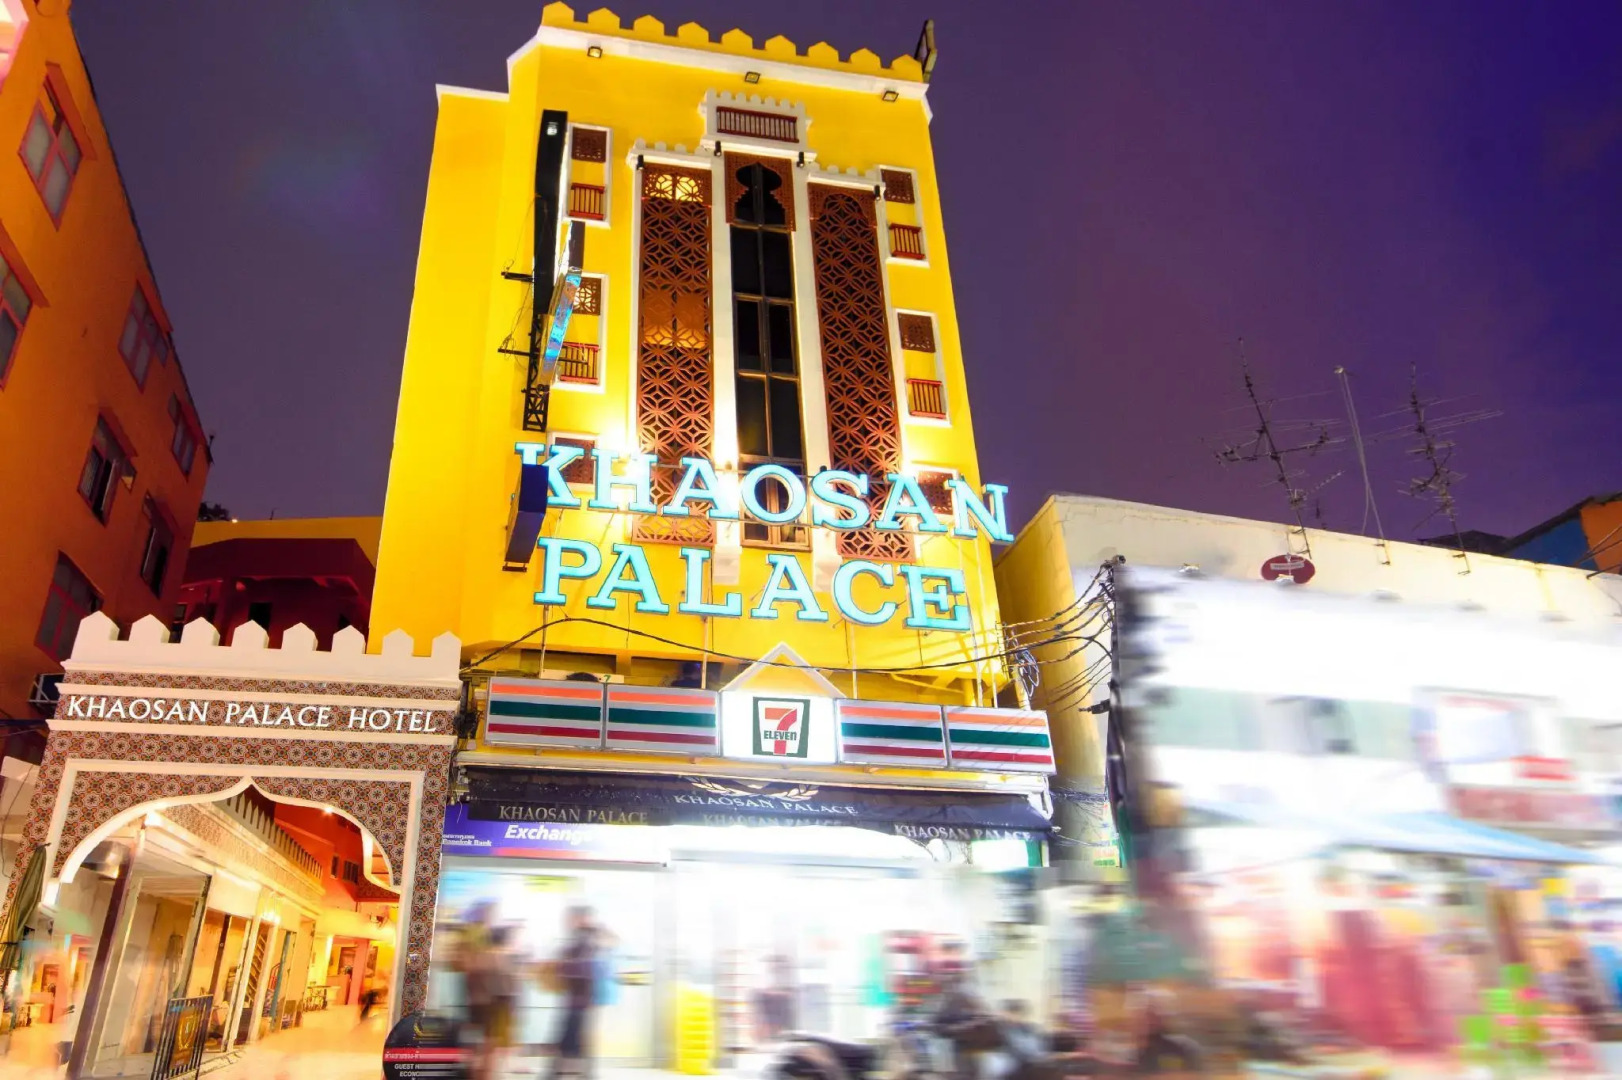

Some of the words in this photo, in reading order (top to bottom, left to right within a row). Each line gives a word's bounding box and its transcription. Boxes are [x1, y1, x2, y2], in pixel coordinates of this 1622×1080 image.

[514, 441, 1015, 544] KHAOSAN
[533, 537, 972, 631] PALACE
[66, 695, 209, 723] KHAOSAN
[224, 702, 332, 729] PALACE
[348, 708, 438, 733] HOTEL
[764, 707, 797, 755] 7
[499, 805, 581, 822] KHAOSAN
[586, 808, 649, 824] PALACE
[673, 794, 775, 809] KHAOSAN
[781, 801, 860, 816] PALACE
[704, 813, 779, 827] KHAOSAN
[893, 823, 970, 840] KHAOSAN
[974, 828, 1032, 841] PALACE
